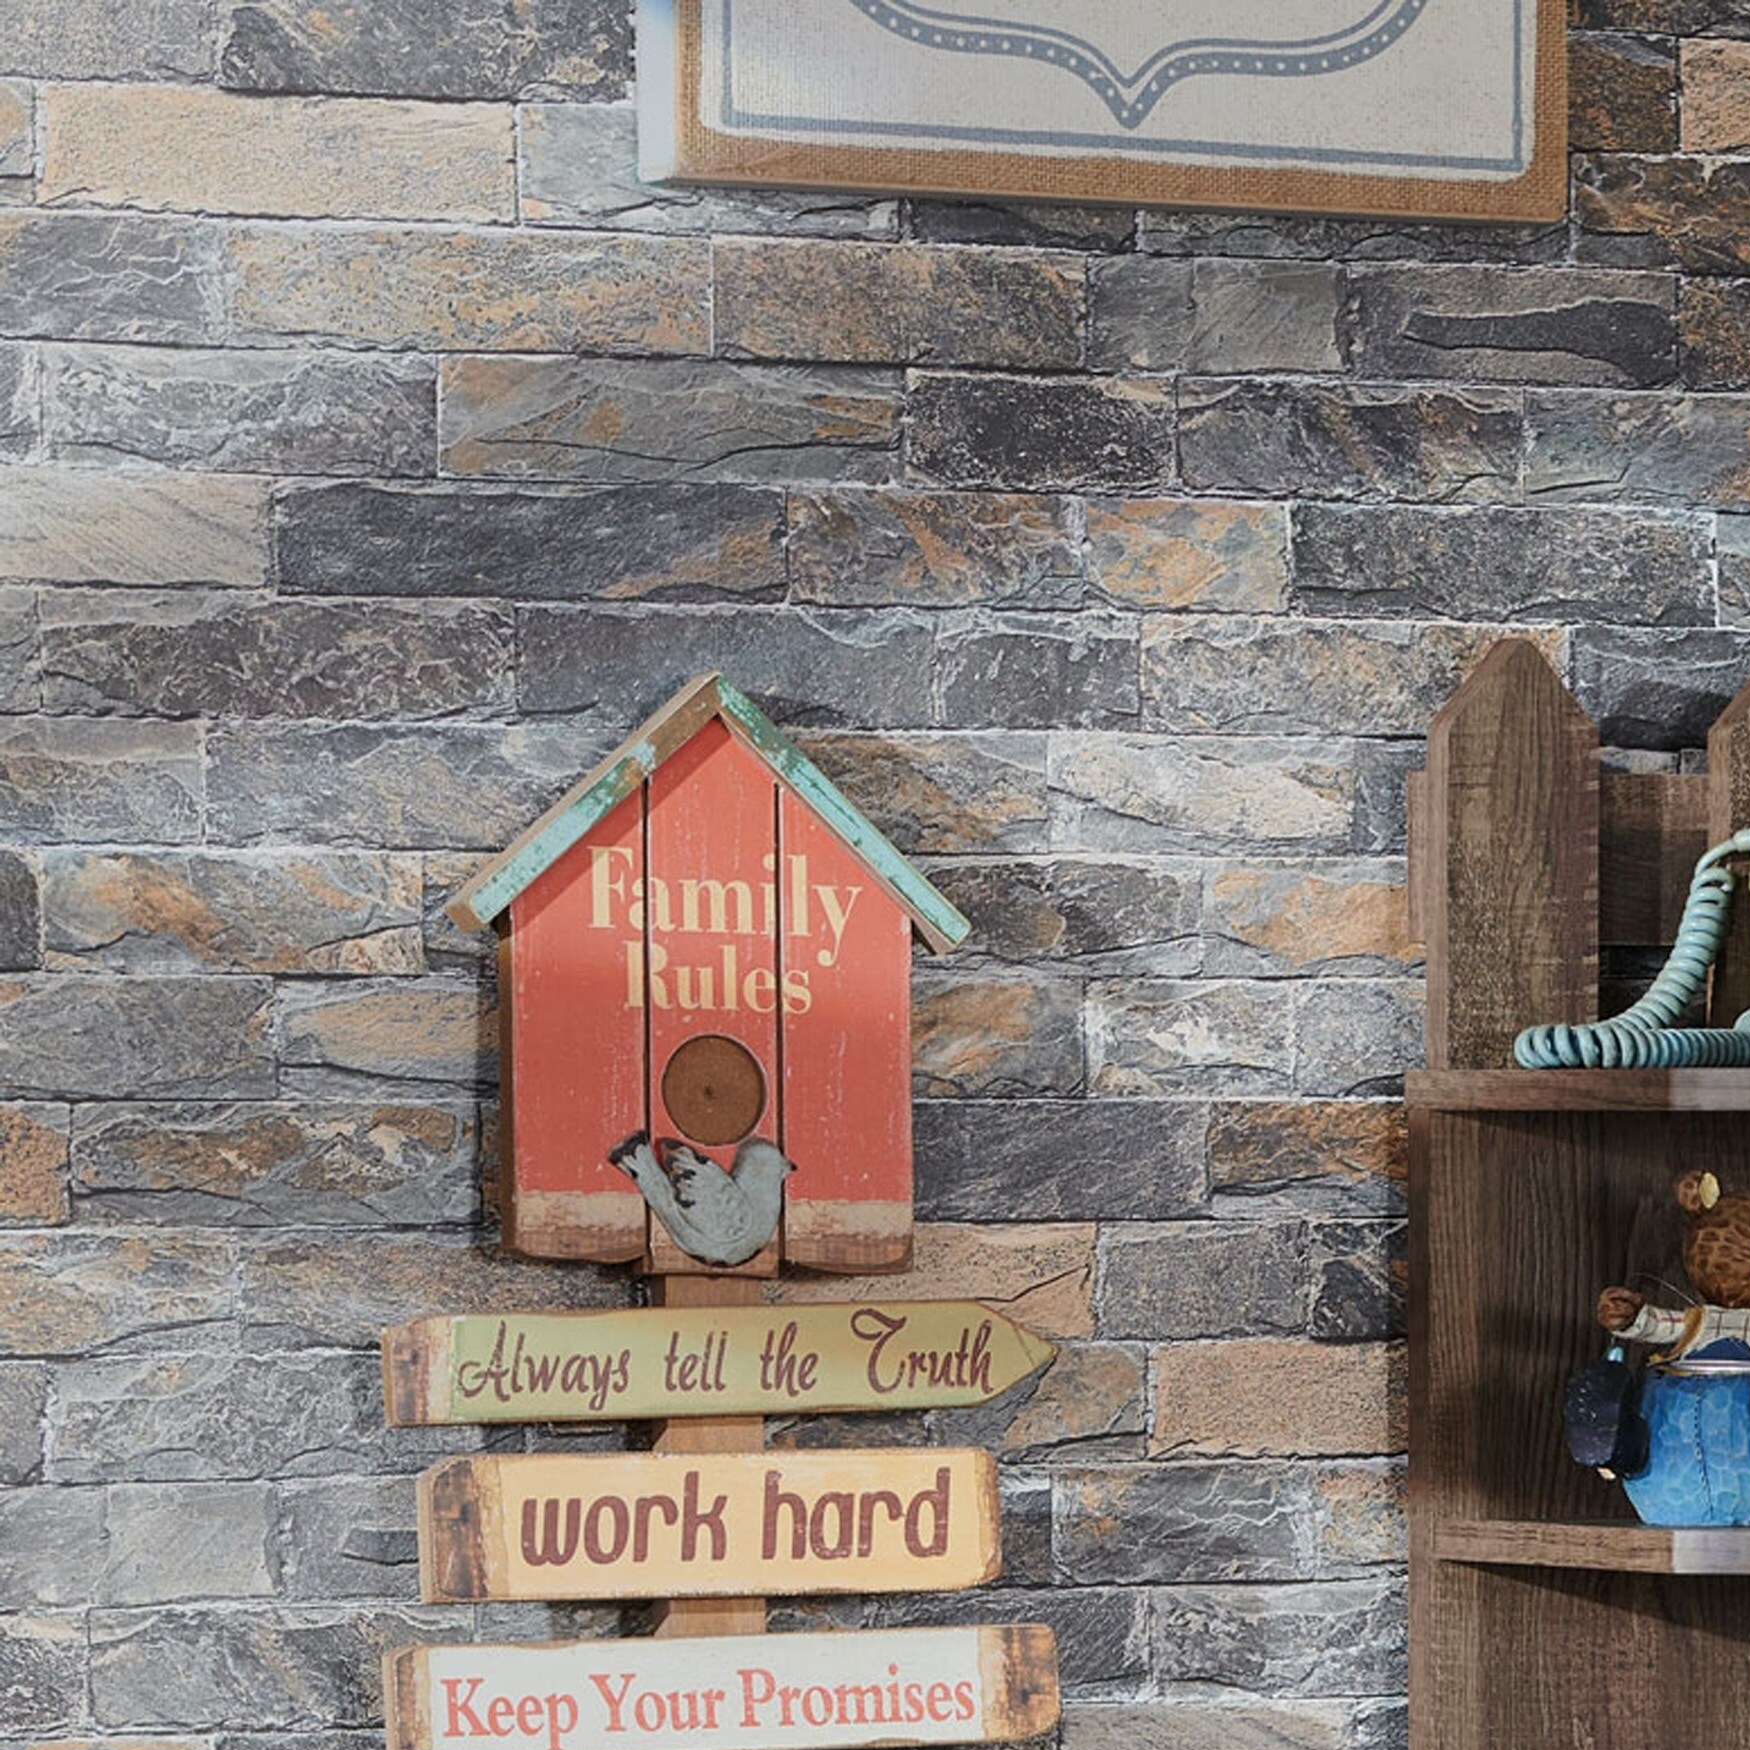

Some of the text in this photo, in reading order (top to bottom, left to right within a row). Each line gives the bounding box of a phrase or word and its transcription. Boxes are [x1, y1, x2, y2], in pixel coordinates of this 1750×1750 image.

[587, 845, 864, 967] Family
[622, 940, 813, 1015] Rules
[457, 1307, 995, 1411] Always tell the Truth
[519, 1466, 953, 1568] work hard
[588, 1671, 726, 1733] Your
[736, 1662, 977, 1729] Promises
